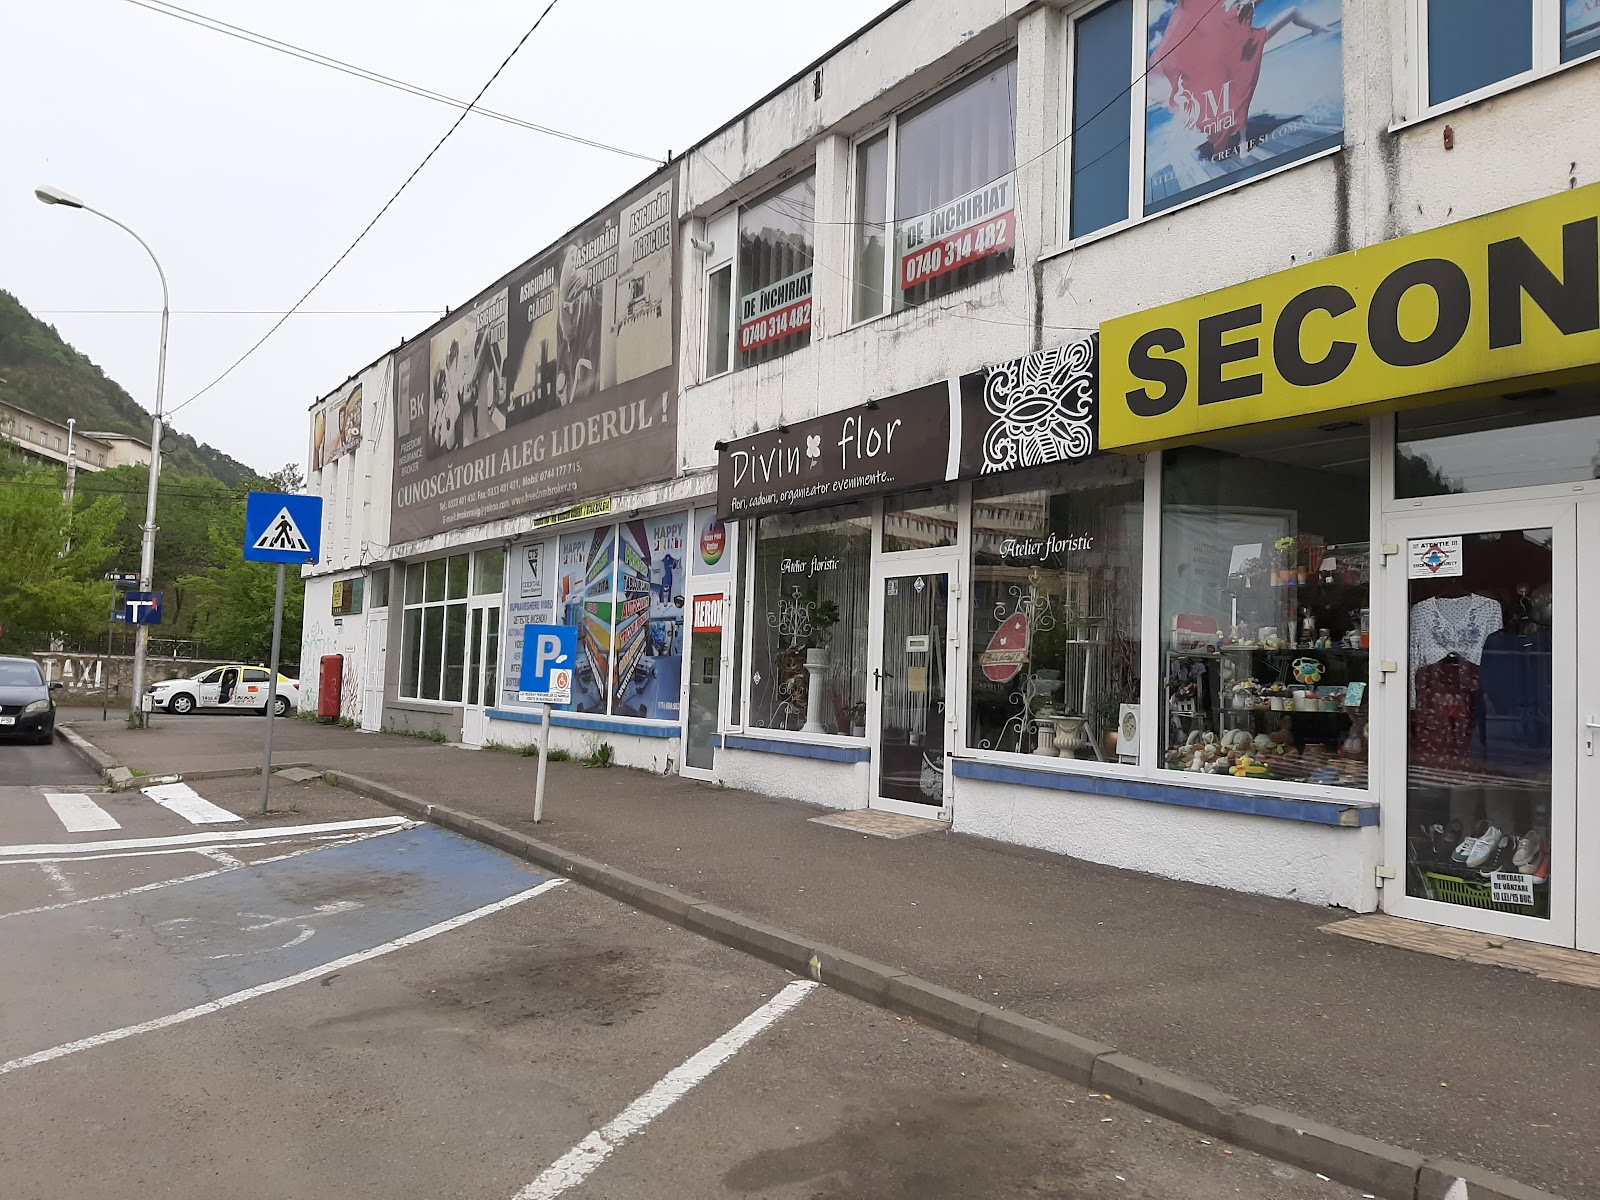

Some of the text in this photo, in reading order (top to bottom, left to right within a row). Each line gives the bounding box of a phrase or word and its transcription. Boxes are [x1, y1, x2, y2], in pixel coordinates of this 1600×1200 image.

[1201, 80, 1234, 123] M
[1203, 110, 1236, 136] miral
[907, 181, 1010, 248] DE ÎNCHIRIAT
[632, 229, 670, 264] AGRICOLE
[906, 219, 1006, 283] 0740 314 482
[587, 253, 618, 288] BUNURI
[743, 272, 813, 320] DE ÎNCHIRIAT
[742, 302, 811, 347] 0740 314 482
[410, 392, 424, 421] BK
[397, 452, 496, 508] CUNOSCĂTORII
[499, 433, 546, 475] ALEG
[551, 398, 653, 458] LIDERUL
[399, 447, 423, 467] INSURANCE
[400, 436, 422, 454] FREEDOM
[730, 414, 902, 489] Divin flor
[401, 461, 419, 477] BROKER
[540, 468, 555, 482] 0744
[556, 464, 567, 477] 177
[749, 492, 779, 508] cadouri,
[780, 482, 831, 505] organizator
[653, 523, 684, 541] HAPPY
[999, 532, 1094, 561] Atelier floristic
[528, 548, 539, 560] CTS
[563, 540, 586, 554] HAPPY
[780, 555, 839, 578] Atelier floristic
[694, 599, 723, 628] XEROX
[535, 634, 562, 678] P
[42, 658, 102, 688] TAXI
[1493, 882, 1502, 890] DE
[1493, 892, 1501, 901] 10
